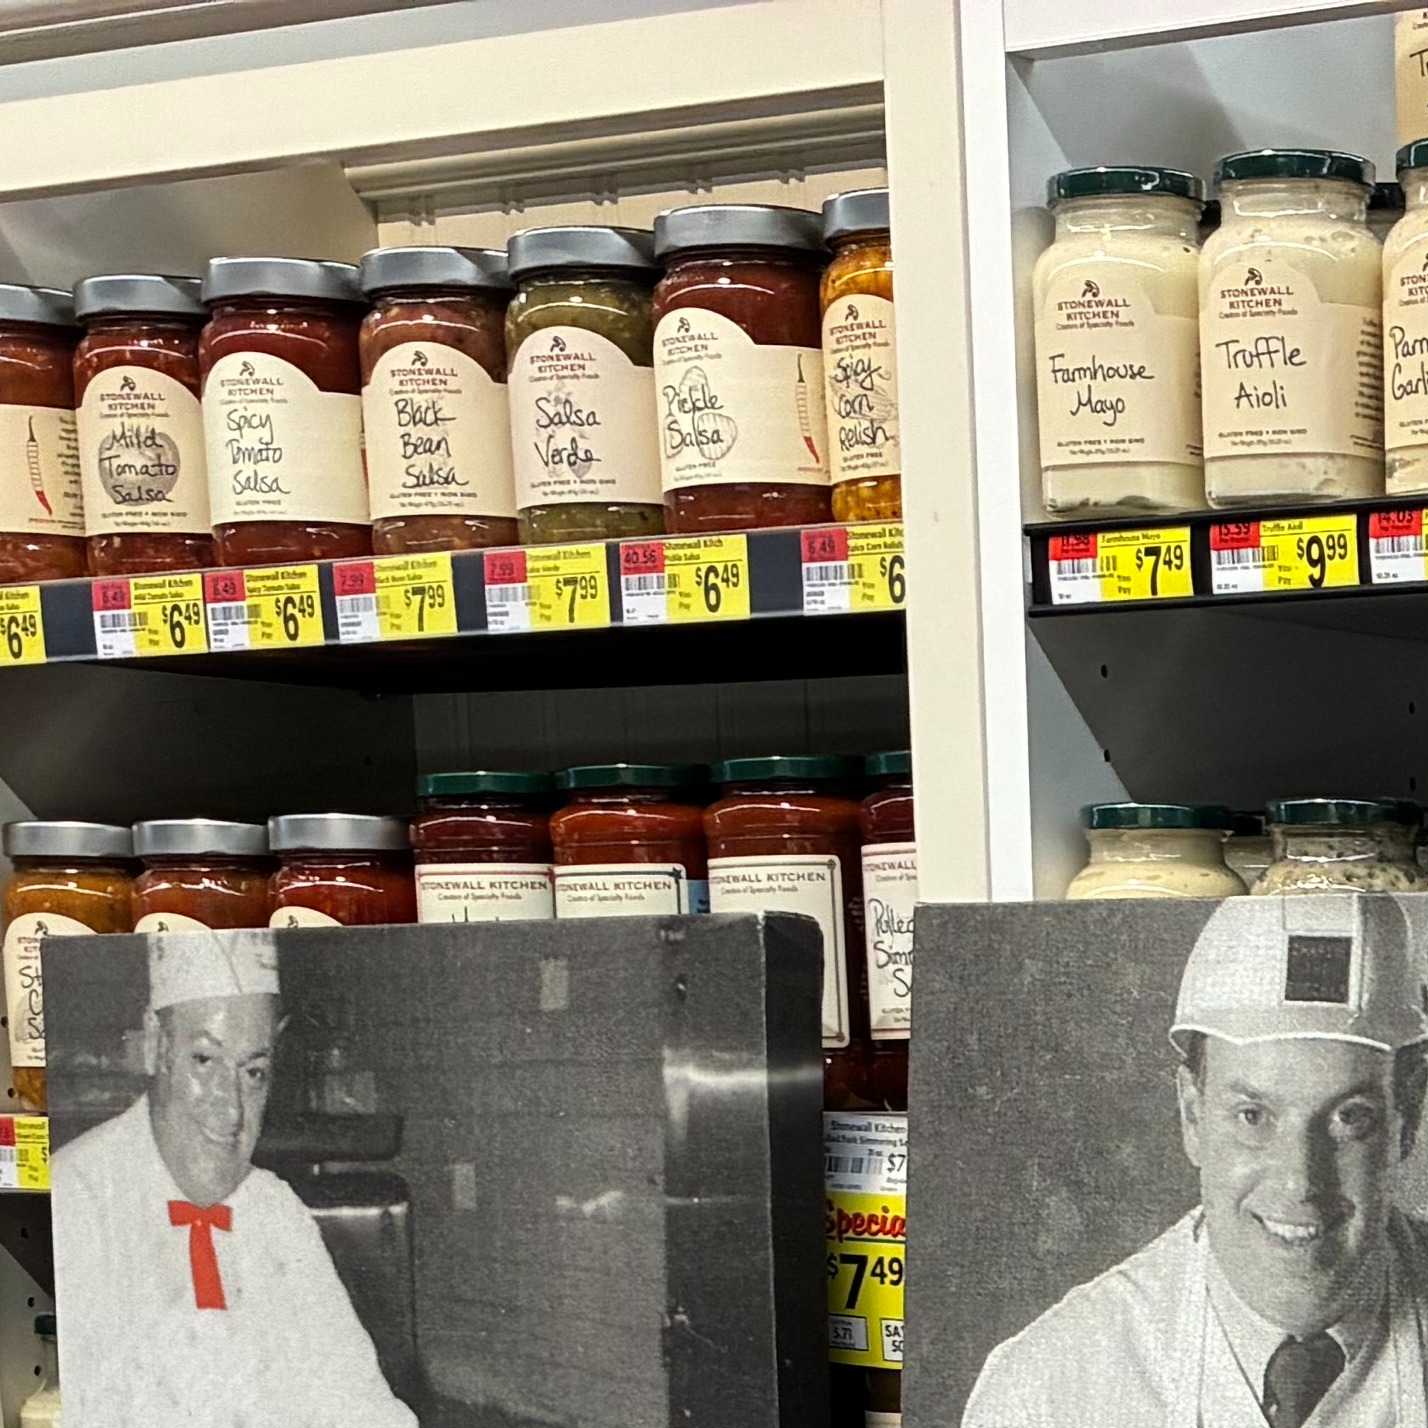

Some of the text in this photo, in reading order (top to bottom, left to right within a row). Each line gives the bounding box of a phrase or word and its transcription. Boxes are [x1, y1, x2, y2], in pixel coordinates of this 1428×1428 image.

[1049, 353, 1155, 384] Farmhouse
[1215, 336, 1307, 370] Truffle
[833, 356, 882, 391] Spicy
[663, 384, 724, 417] Pickle
[1070, 384, 1126, 427] Mayo
[1235, 379, 1287, 410] Aioli
[226, 406, 274, 445] Spicy
[394, 398, 457, 427] Black
[535, 396, 601, 429] Salsa
[105, 423, 164, 451] Mild
[400, 433, 452, 459] Bean
[666, 411, 724, 451] Salsa
[838, 424, 890, 452] Relish
[100, 452, 178, 479] Tomato
[534, 435, 602, 468] Verde
[232, 469, 291, 495] Salsa
[401, 464, 470, 489] Salsa
[112, 481, 173, 504] Salsa
